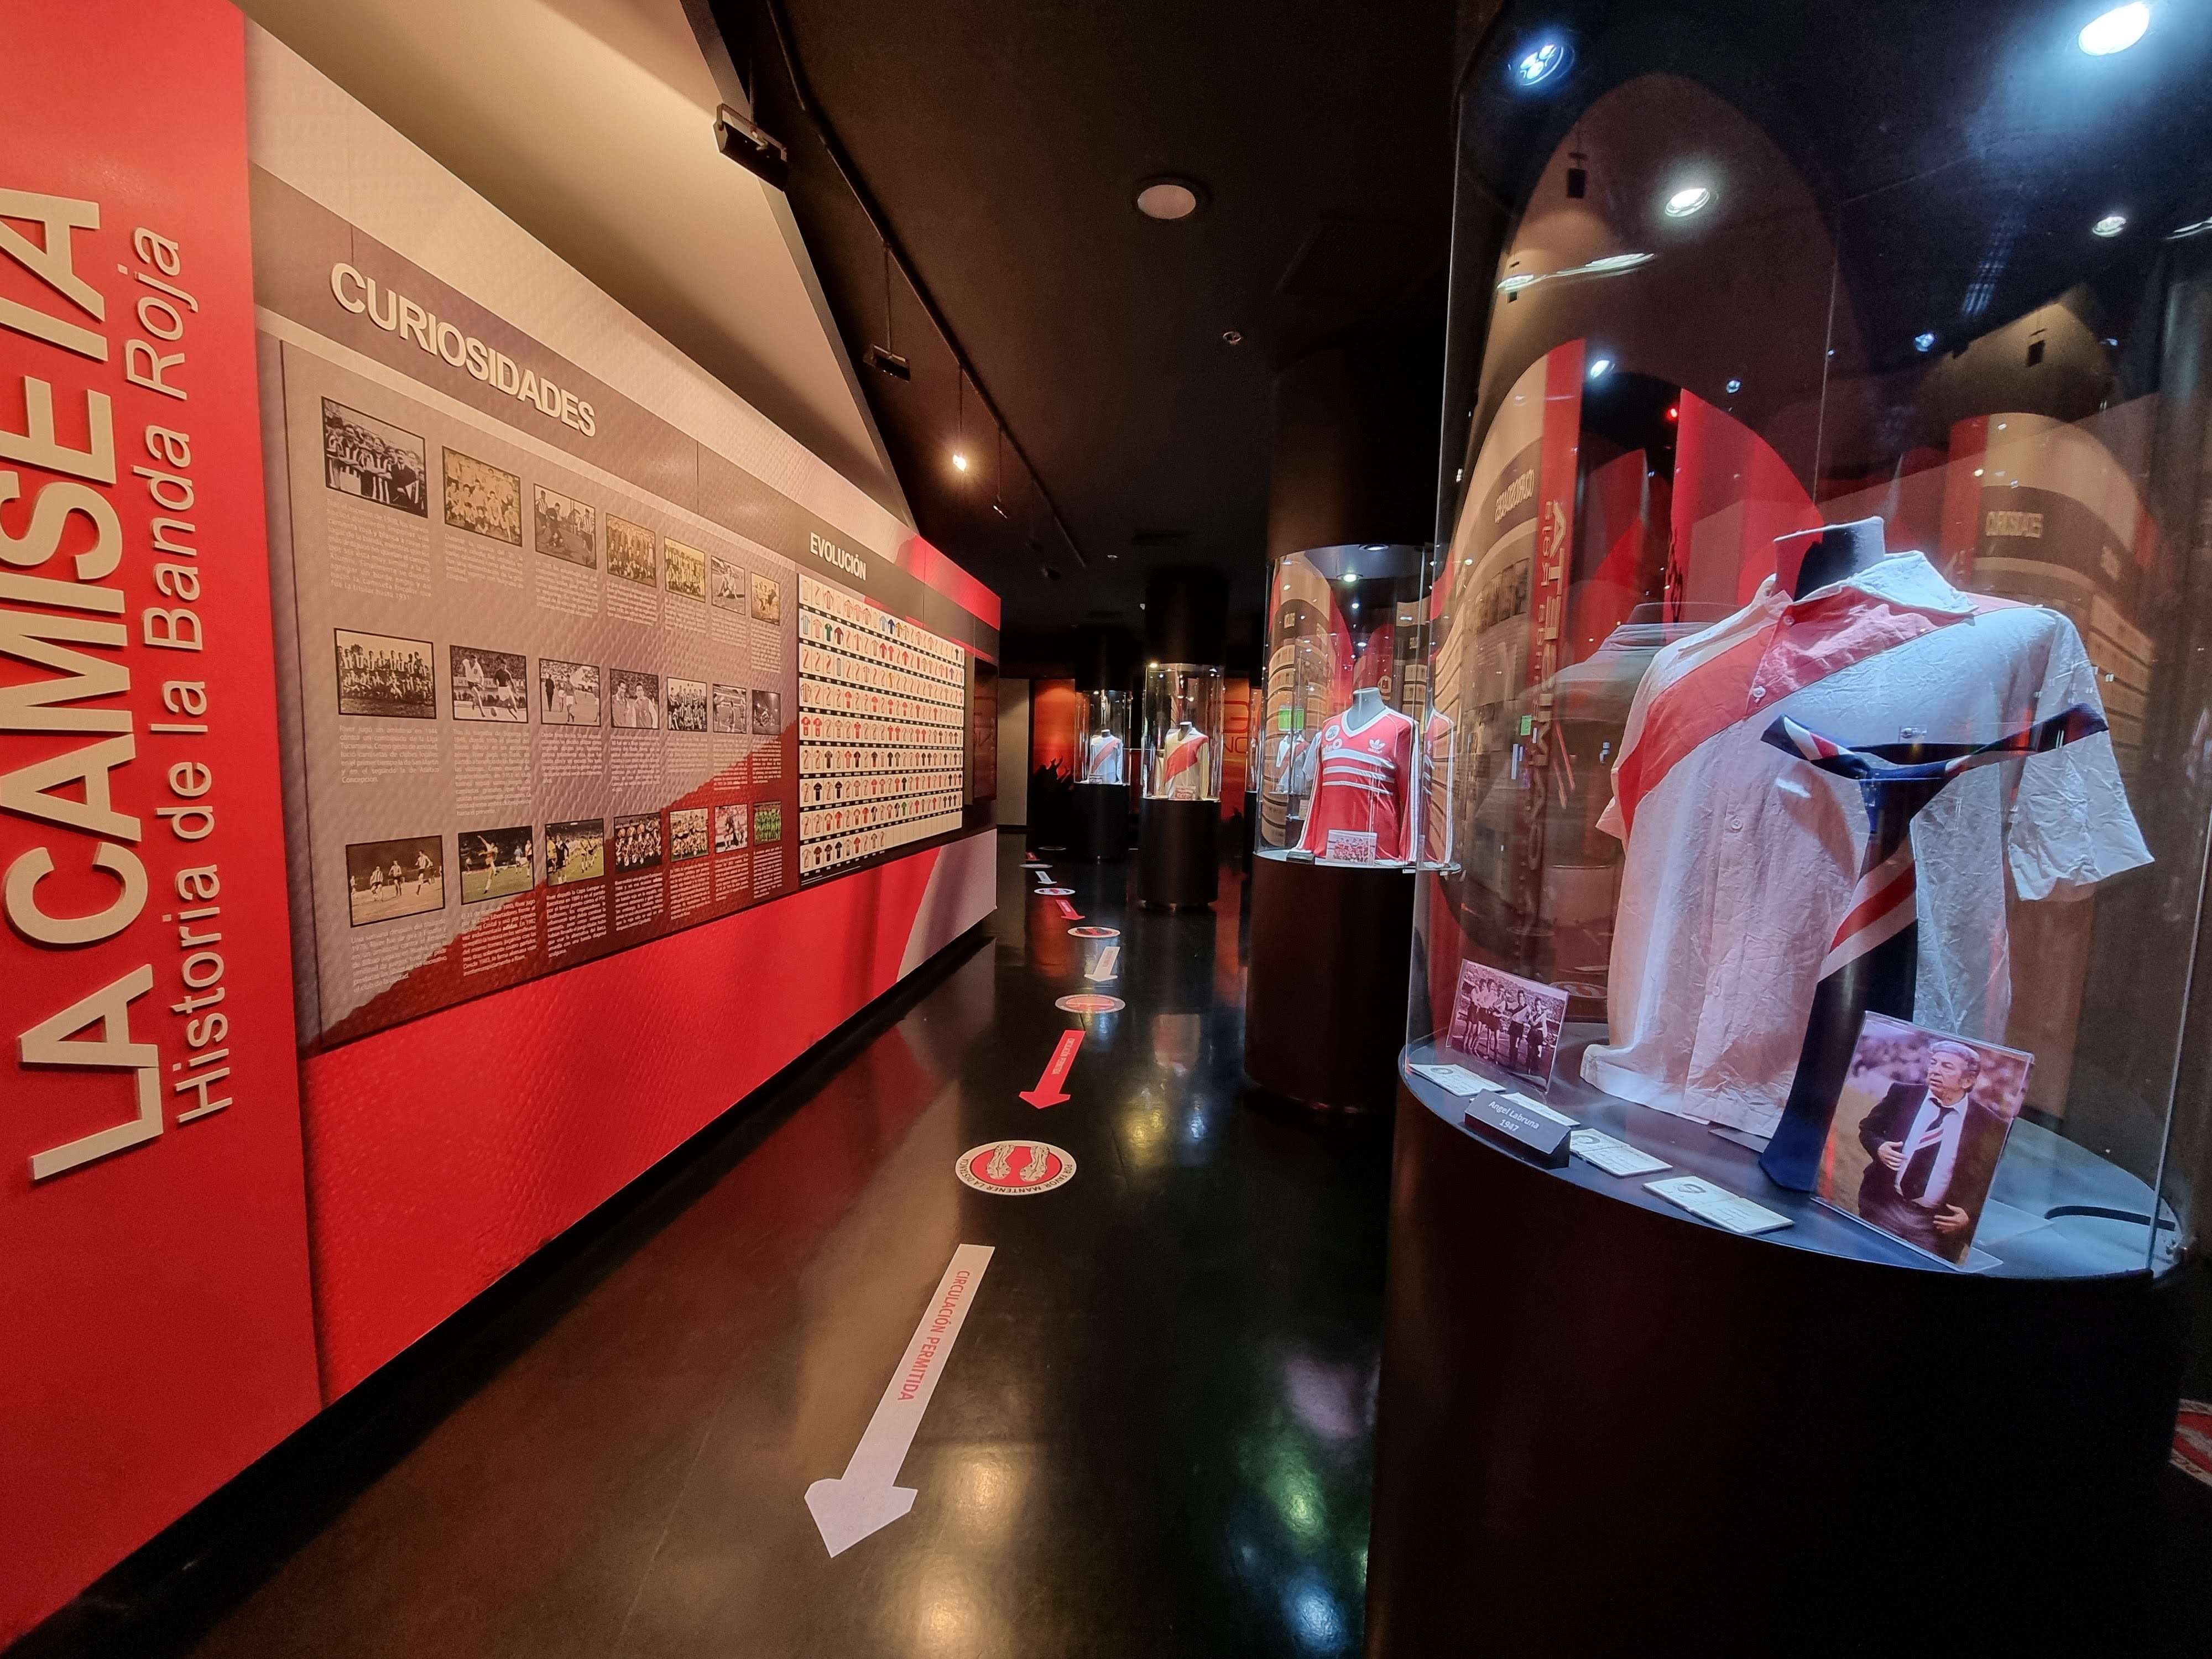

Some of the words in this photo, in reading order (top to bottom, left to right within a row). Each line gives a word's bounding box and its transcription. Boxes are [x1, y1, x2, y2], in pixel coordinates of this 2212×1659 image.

[117, 226, 199, 401] Roja
[331, 262, 596, 437] CURIOSIDADES
[131, 424, 204, 651] Banda
[810, 531, 866, 581] EVOLUCIÓN
[149, 680, 209, 733] la
[155, 761, 215, 841] de
[175, 863, 233, 1124] Historia
[18, 964, 164, 1180] LA
[1488, 1101, 1511, 1115] Angel
[1509, 1110, 1540, 1129] Labruna
[960, 1159, 973, 1182] DISTANCIA
[987, 1185, 1042, 1193] MANTENER
[1046, 1174, 1068, 1188] FAVOR
[1065, 1164, 1073, 1175] POR
[931, 1270, 970, 1333] CIRCULACIÓN
[898, 1337, 940, 1401] PERMITIDA
